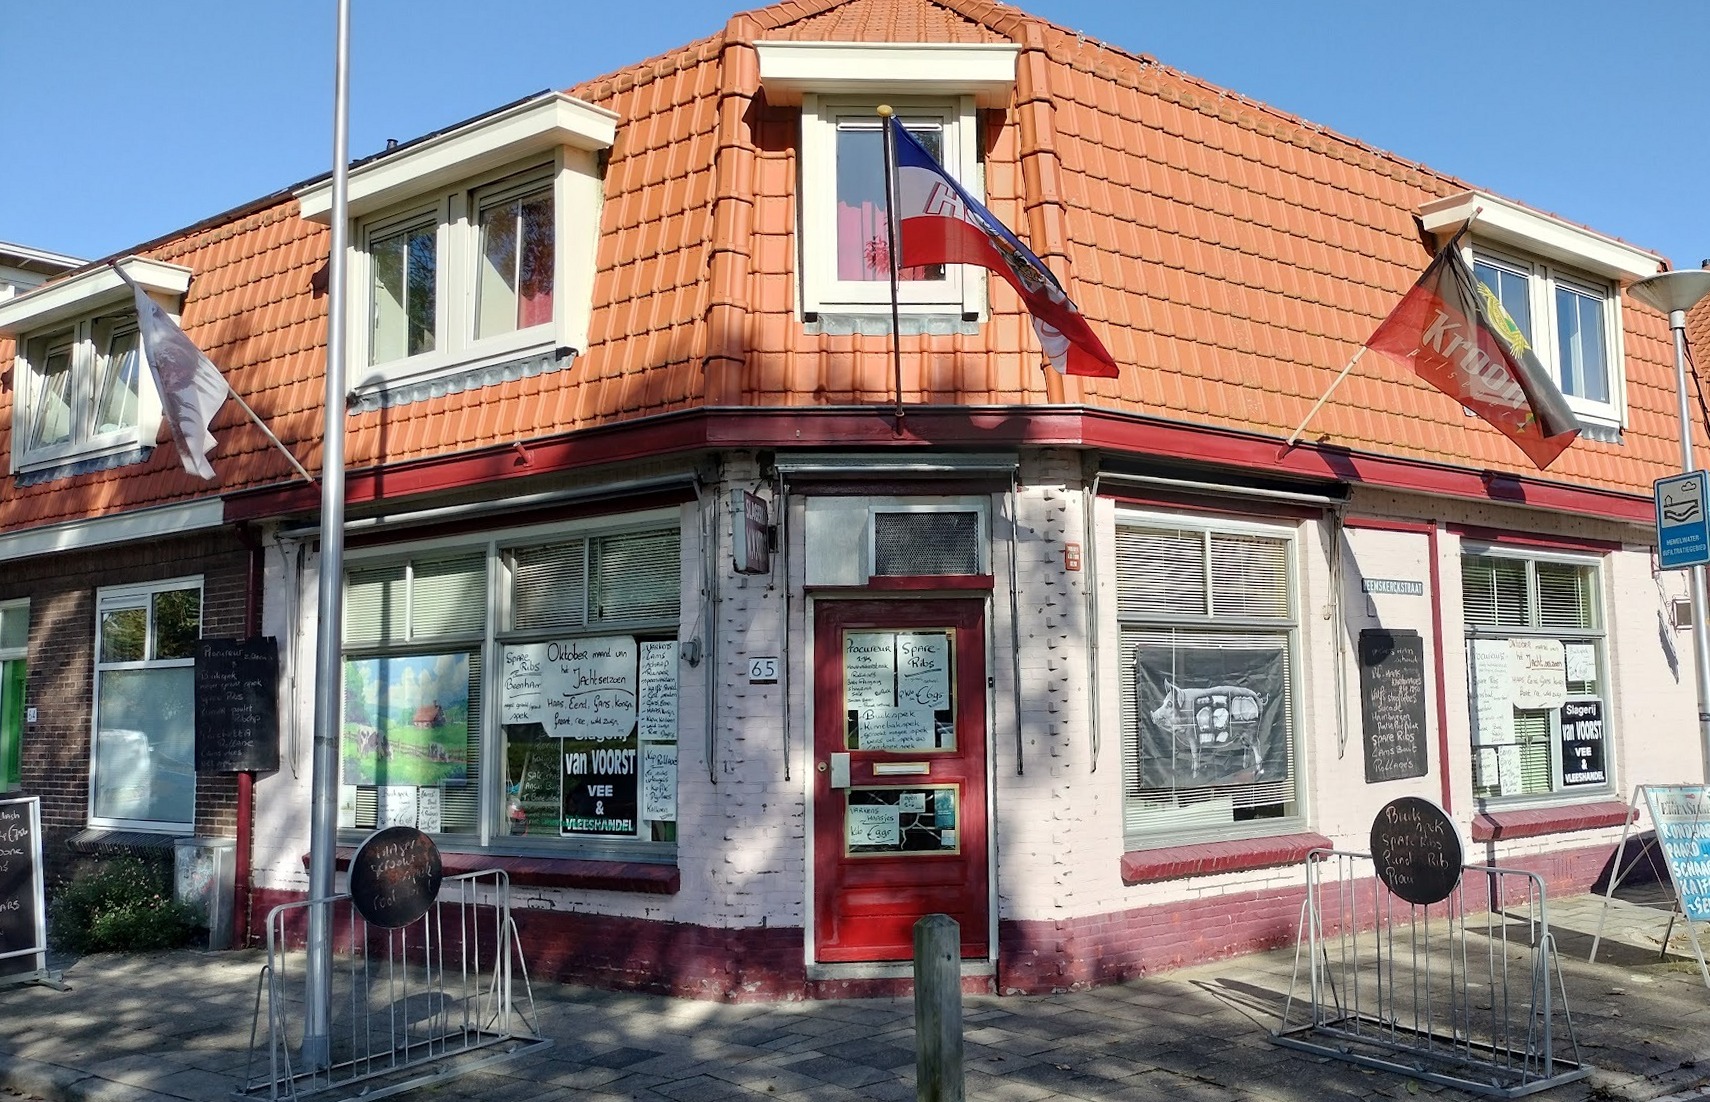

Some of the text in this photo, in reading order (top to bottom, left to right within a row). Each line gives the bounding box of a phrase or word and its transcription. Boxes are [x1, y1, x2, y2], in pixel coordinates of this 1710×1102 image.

[1422, 308, 1526, 409] Kroon
[548, 642, 588, 662] Oktober
[752, 661, 774, 677] 65
[1566, 704, 1596, 716] Slagerij
[1562, 720, 1602, 741] van VOORST
[1574, 746, 1592, 757] VEE
[566, 752, 588, 774] van
[591, 748, 636, 775] VOORST
[1581, 759, 1588, 770] &
[1564, 770, 1605, 784] VLEESHANDEL
[587, 784, 614, 797] VEE
[595, 800, 604, 816] &
[566, 818, 633, 832] VLEESHANDEL
